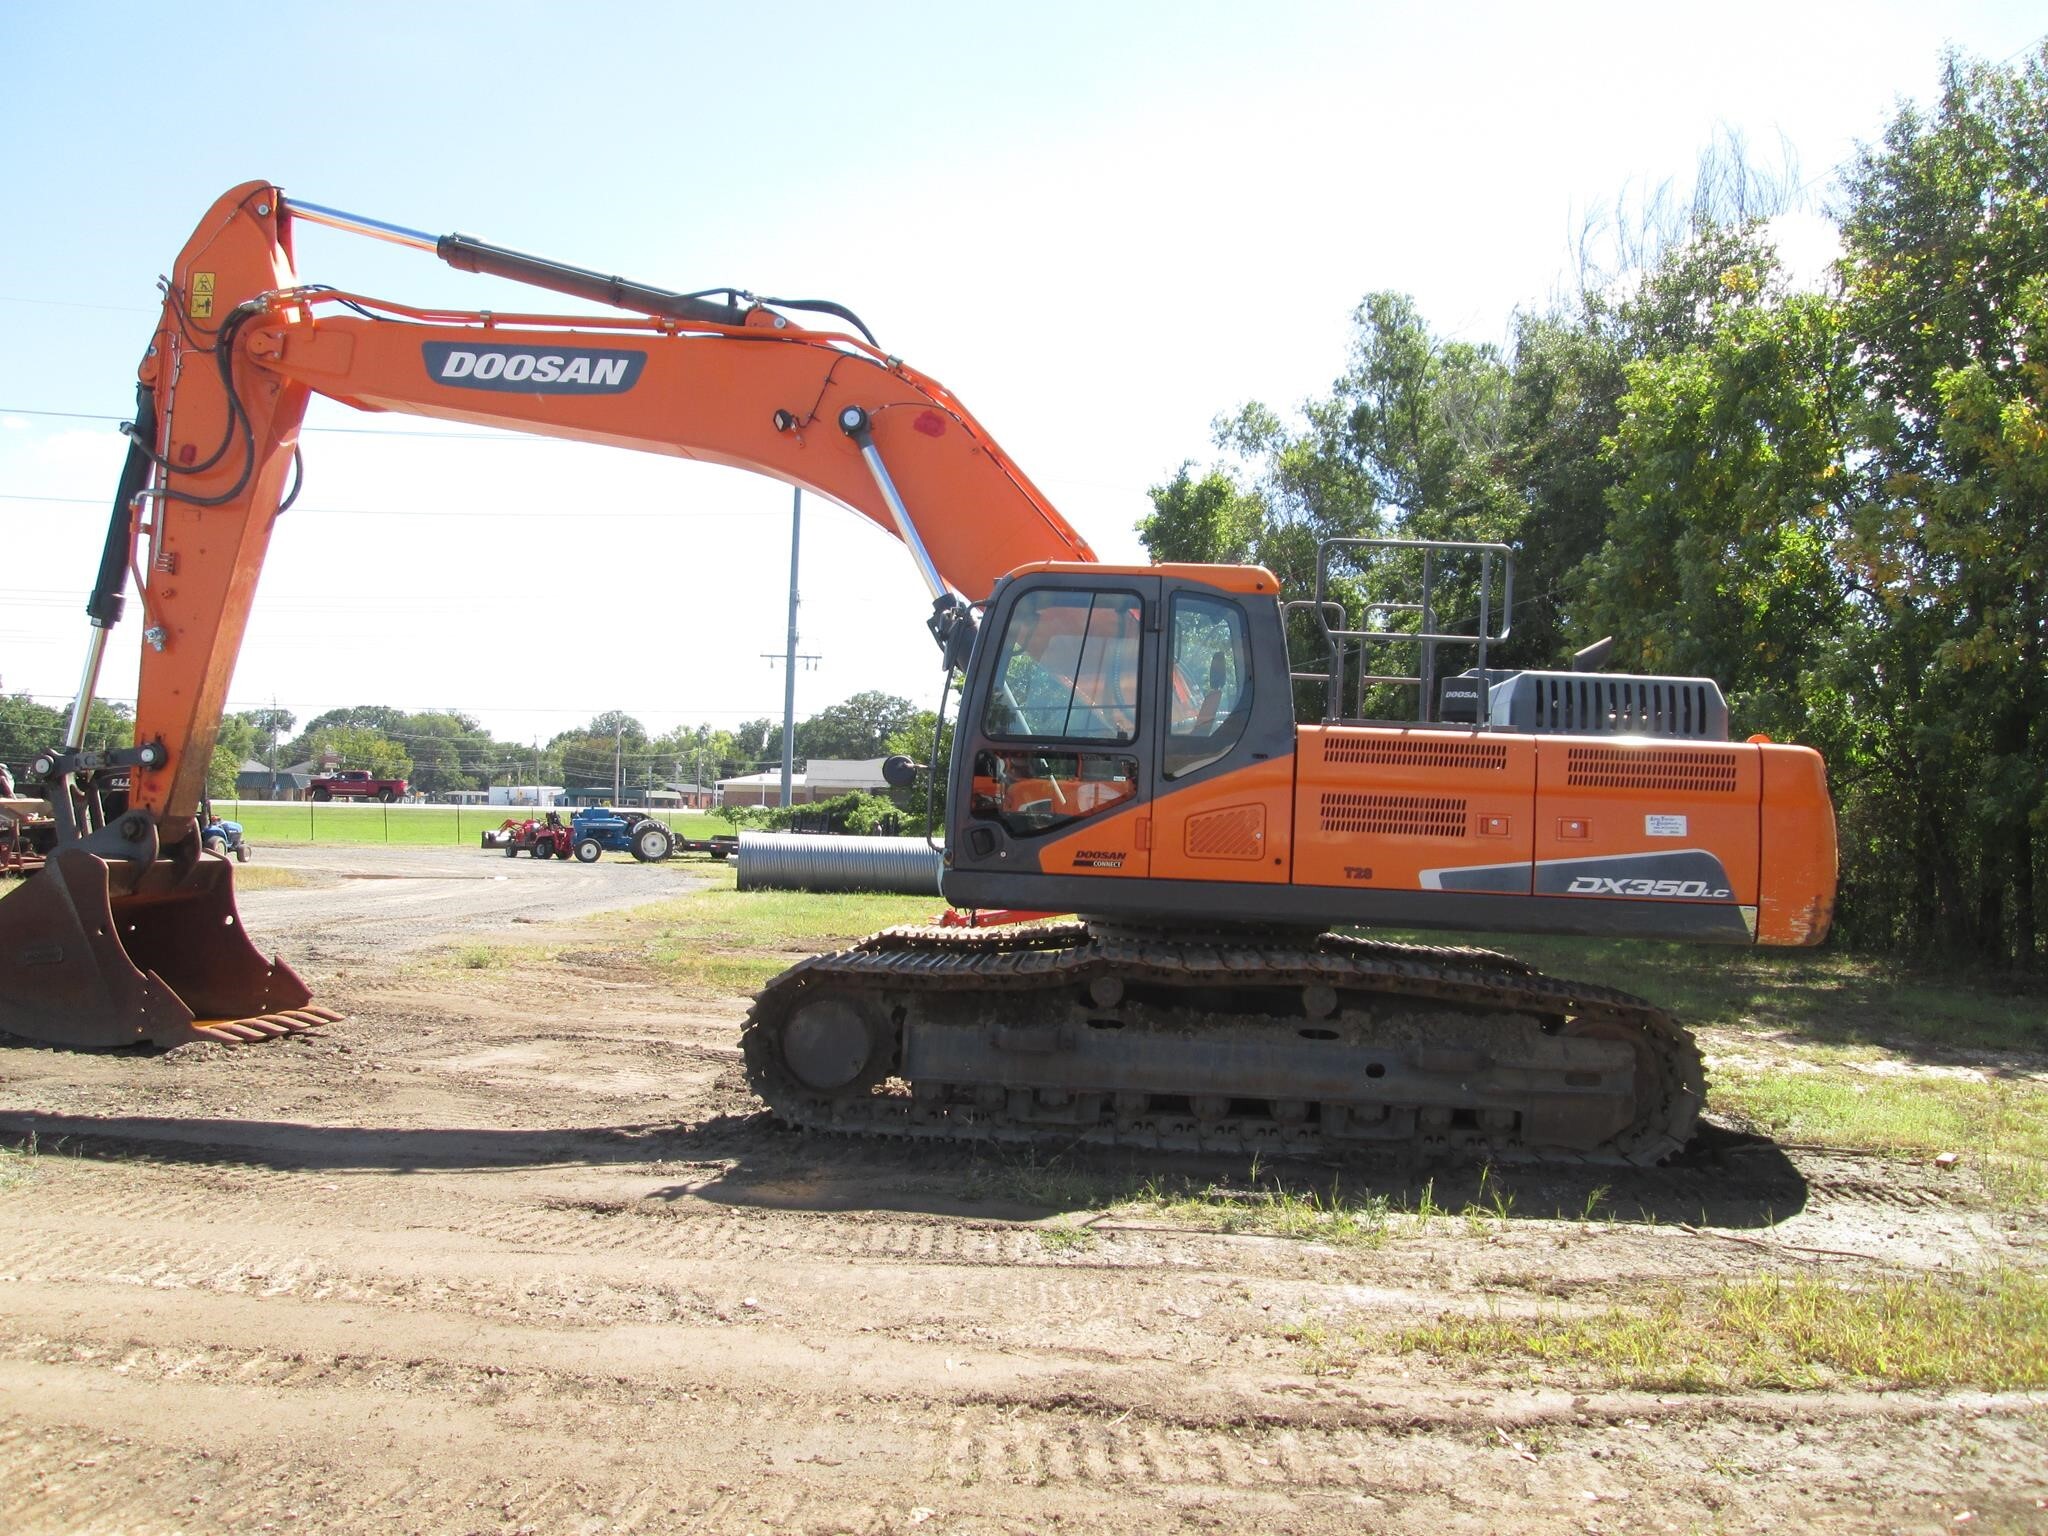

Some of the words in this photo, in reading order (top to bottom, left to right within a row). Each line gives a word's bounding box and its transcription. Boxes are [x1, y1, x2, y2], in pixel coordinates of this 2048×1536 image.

[441, 351, 630, 386] DOOSAN
[1075, 850, 1127, 859] DOOSAN
[1093, 860, 1121, 868] CONNECT
